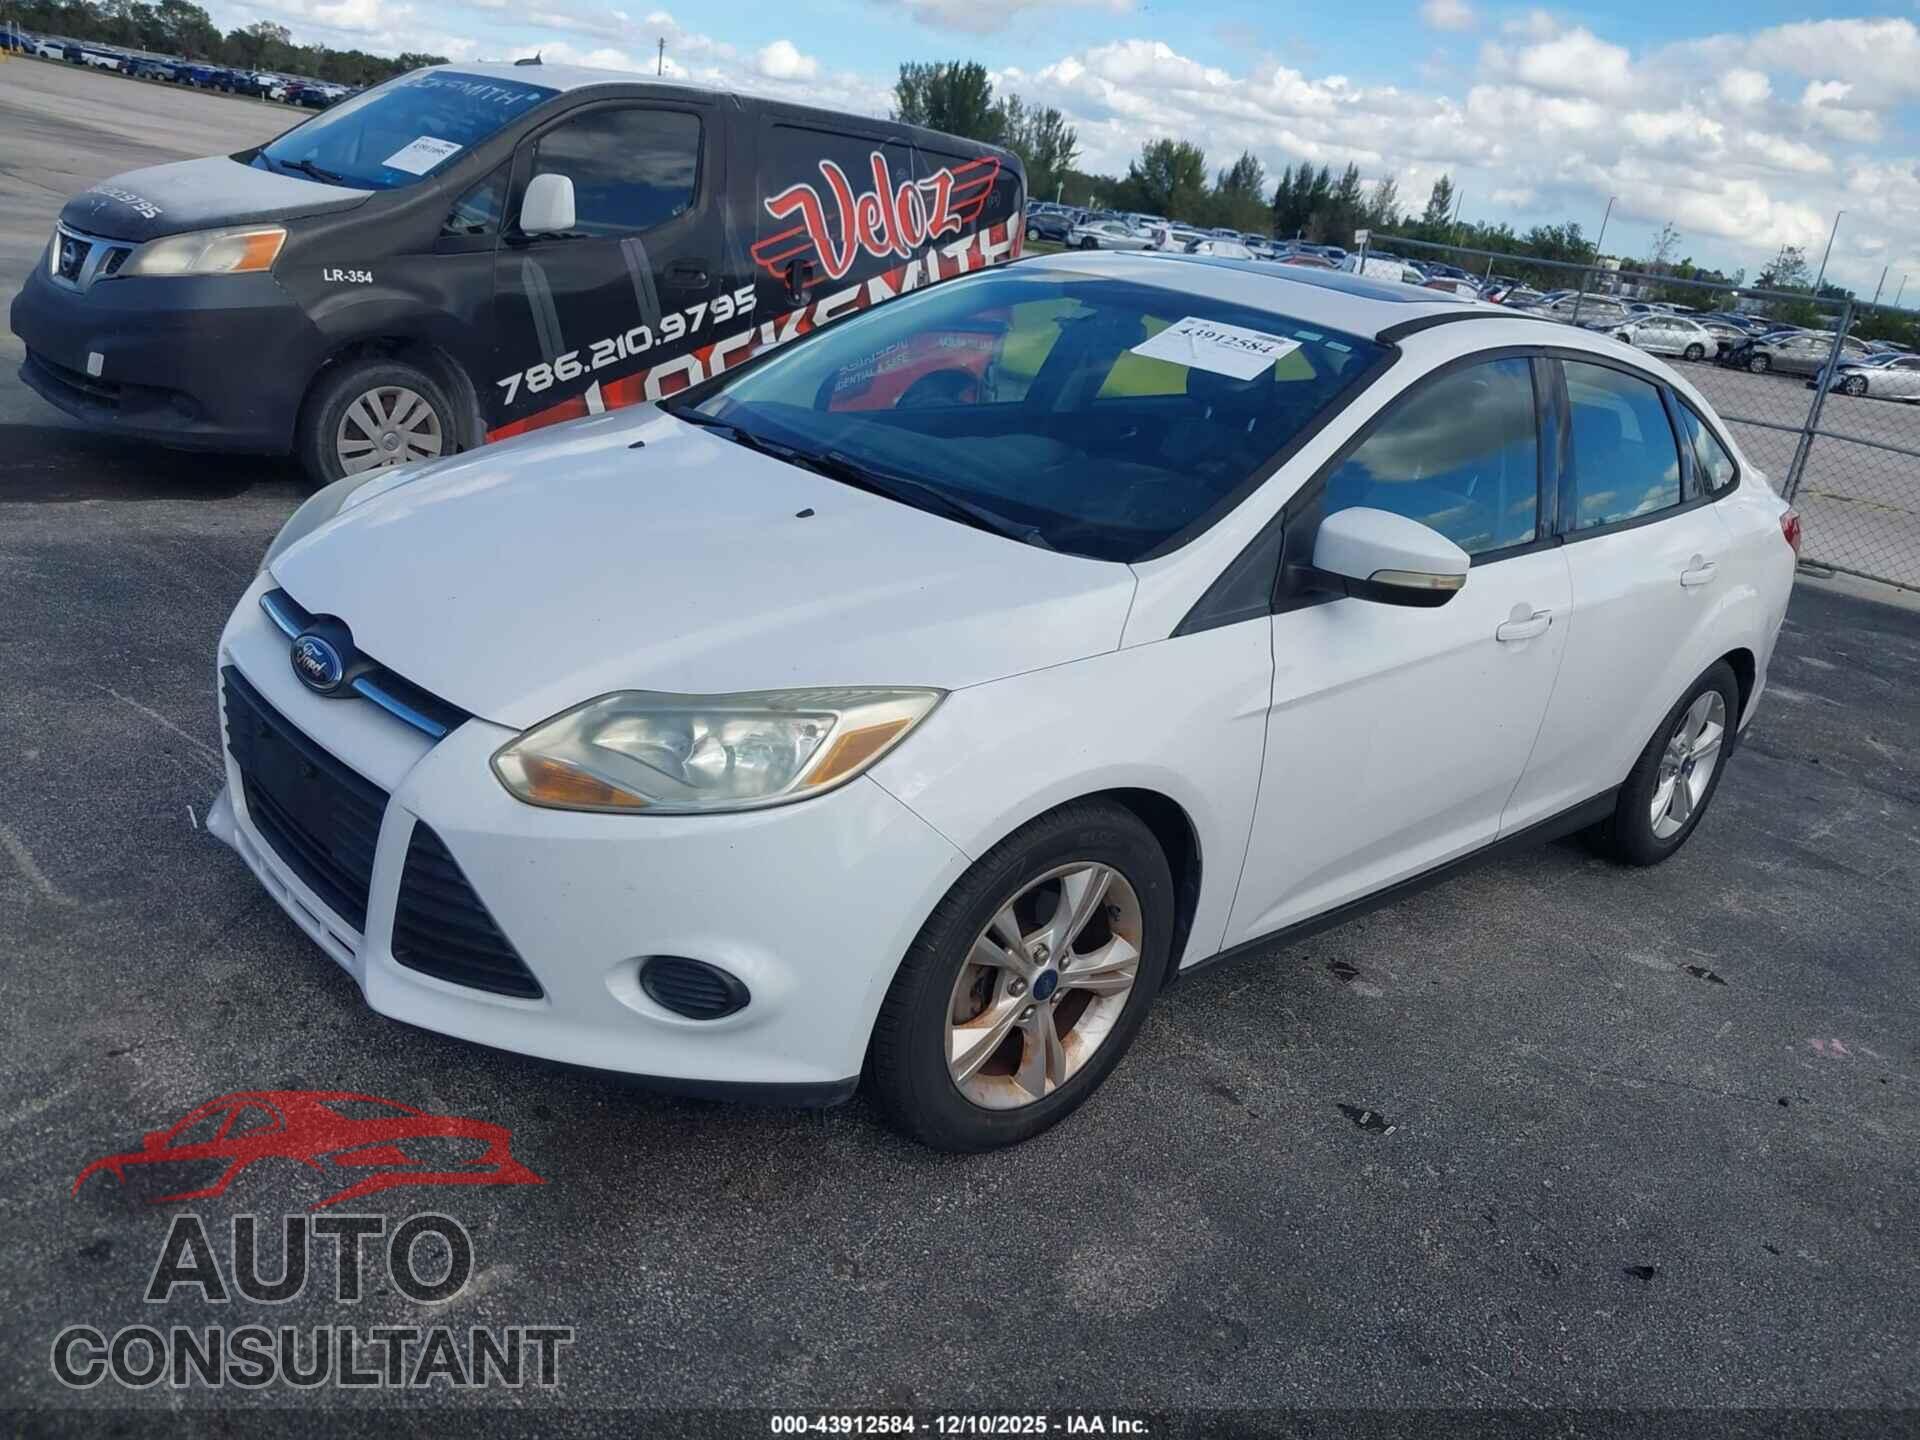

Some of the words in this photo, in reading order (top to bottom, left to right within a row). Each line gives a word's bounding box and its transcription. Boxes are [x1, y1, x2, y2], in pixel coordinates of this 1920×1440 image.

[764, 152, 962, 280] Veloz
[323, 267, 374, 284] LR-354
[496, 284, 758, 406] 786.210.9795
[297, 642, 328, 677] Ford
